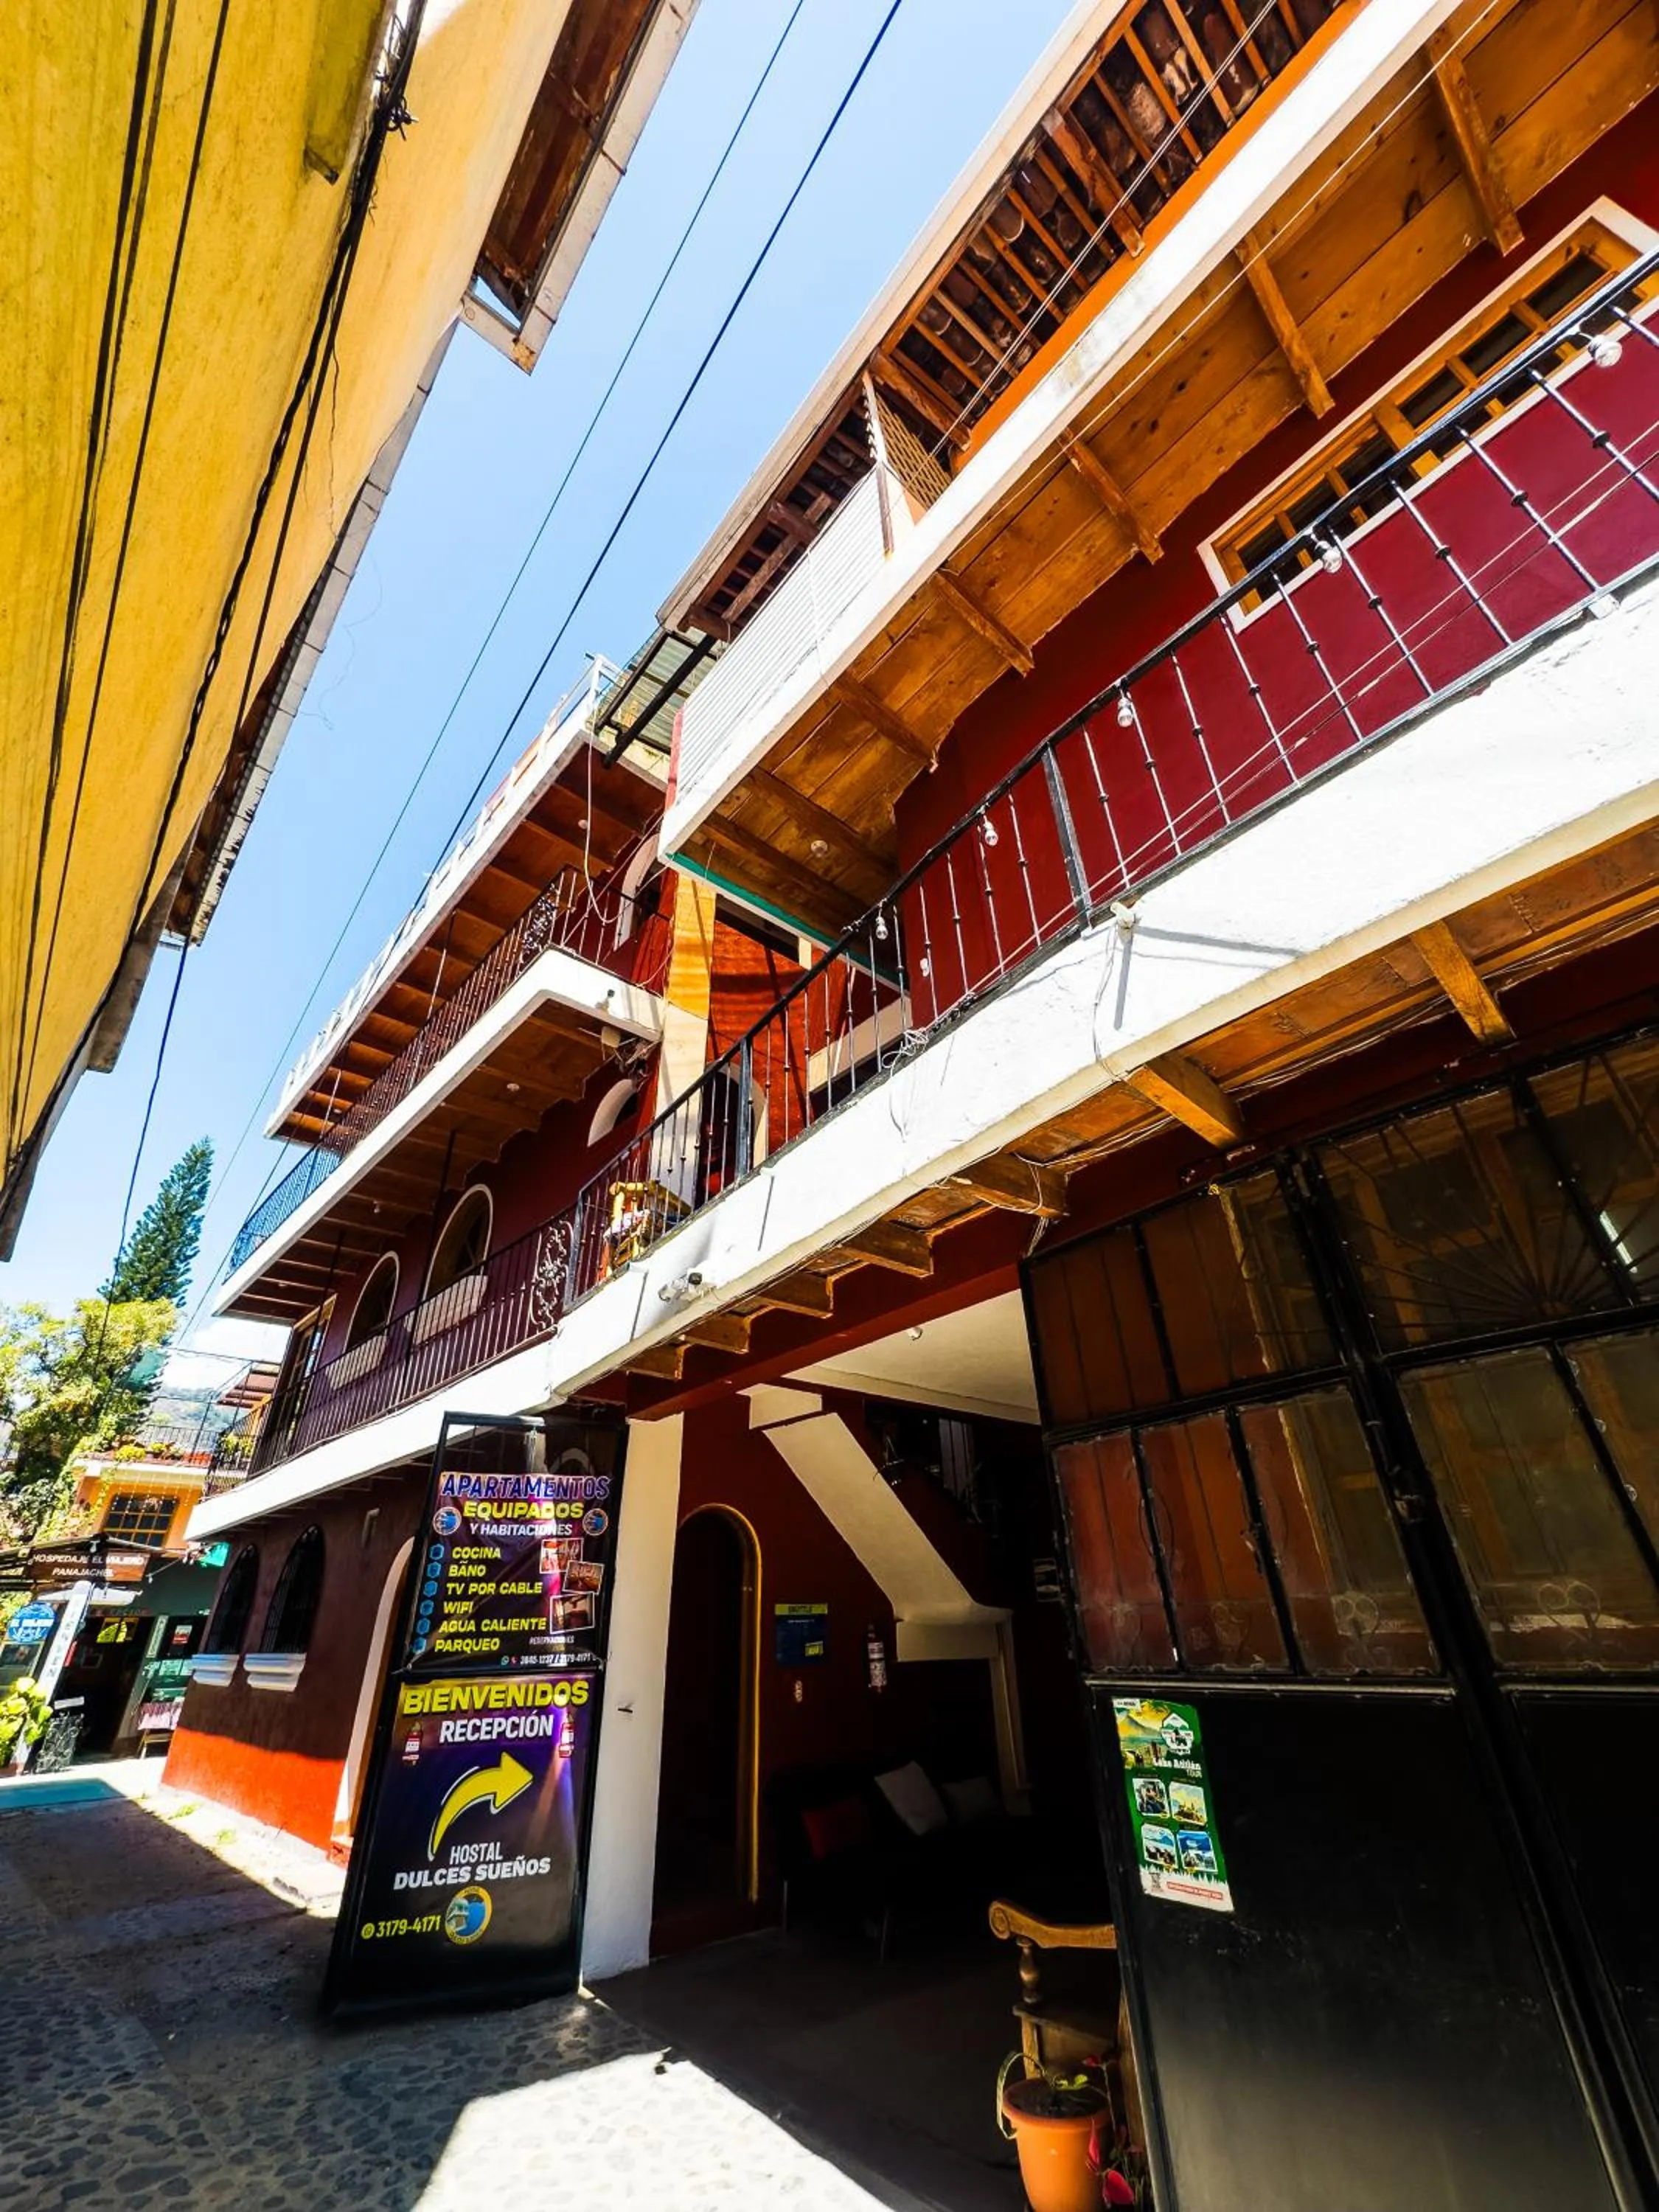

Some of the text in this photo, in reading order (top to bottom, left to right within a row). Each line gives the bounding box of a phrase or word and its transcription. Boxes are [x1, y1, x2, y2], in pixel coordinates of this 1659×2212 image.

[441, 1473, 611, 1500] APARTAMENTOS
[463, 1500, 585, 1520] EQUIPADOS
[470, 1522, 573, 1537] Y HABITACIONES
[451, 1547, 501, 1559] COCINA
[446, 1582, 543, 1595] TV POR CABLE
[443, 1601, 473, 1614] WIFI
[439, 1618, 546, 1633] AGUA CALIENTE
[434, 1638, 500, 1654] PARQUEO
[403, 1680, 589, 1714] BIENVENIDOS
[439, 1709, 554, 1744] RECEPCIÓN
[449, 1842, 503, 1865] HOSTAL
[394, 1854, 552, 1891] DULCES SUEÑOS
[376, 1915, 442, 1938] 3179-4171
